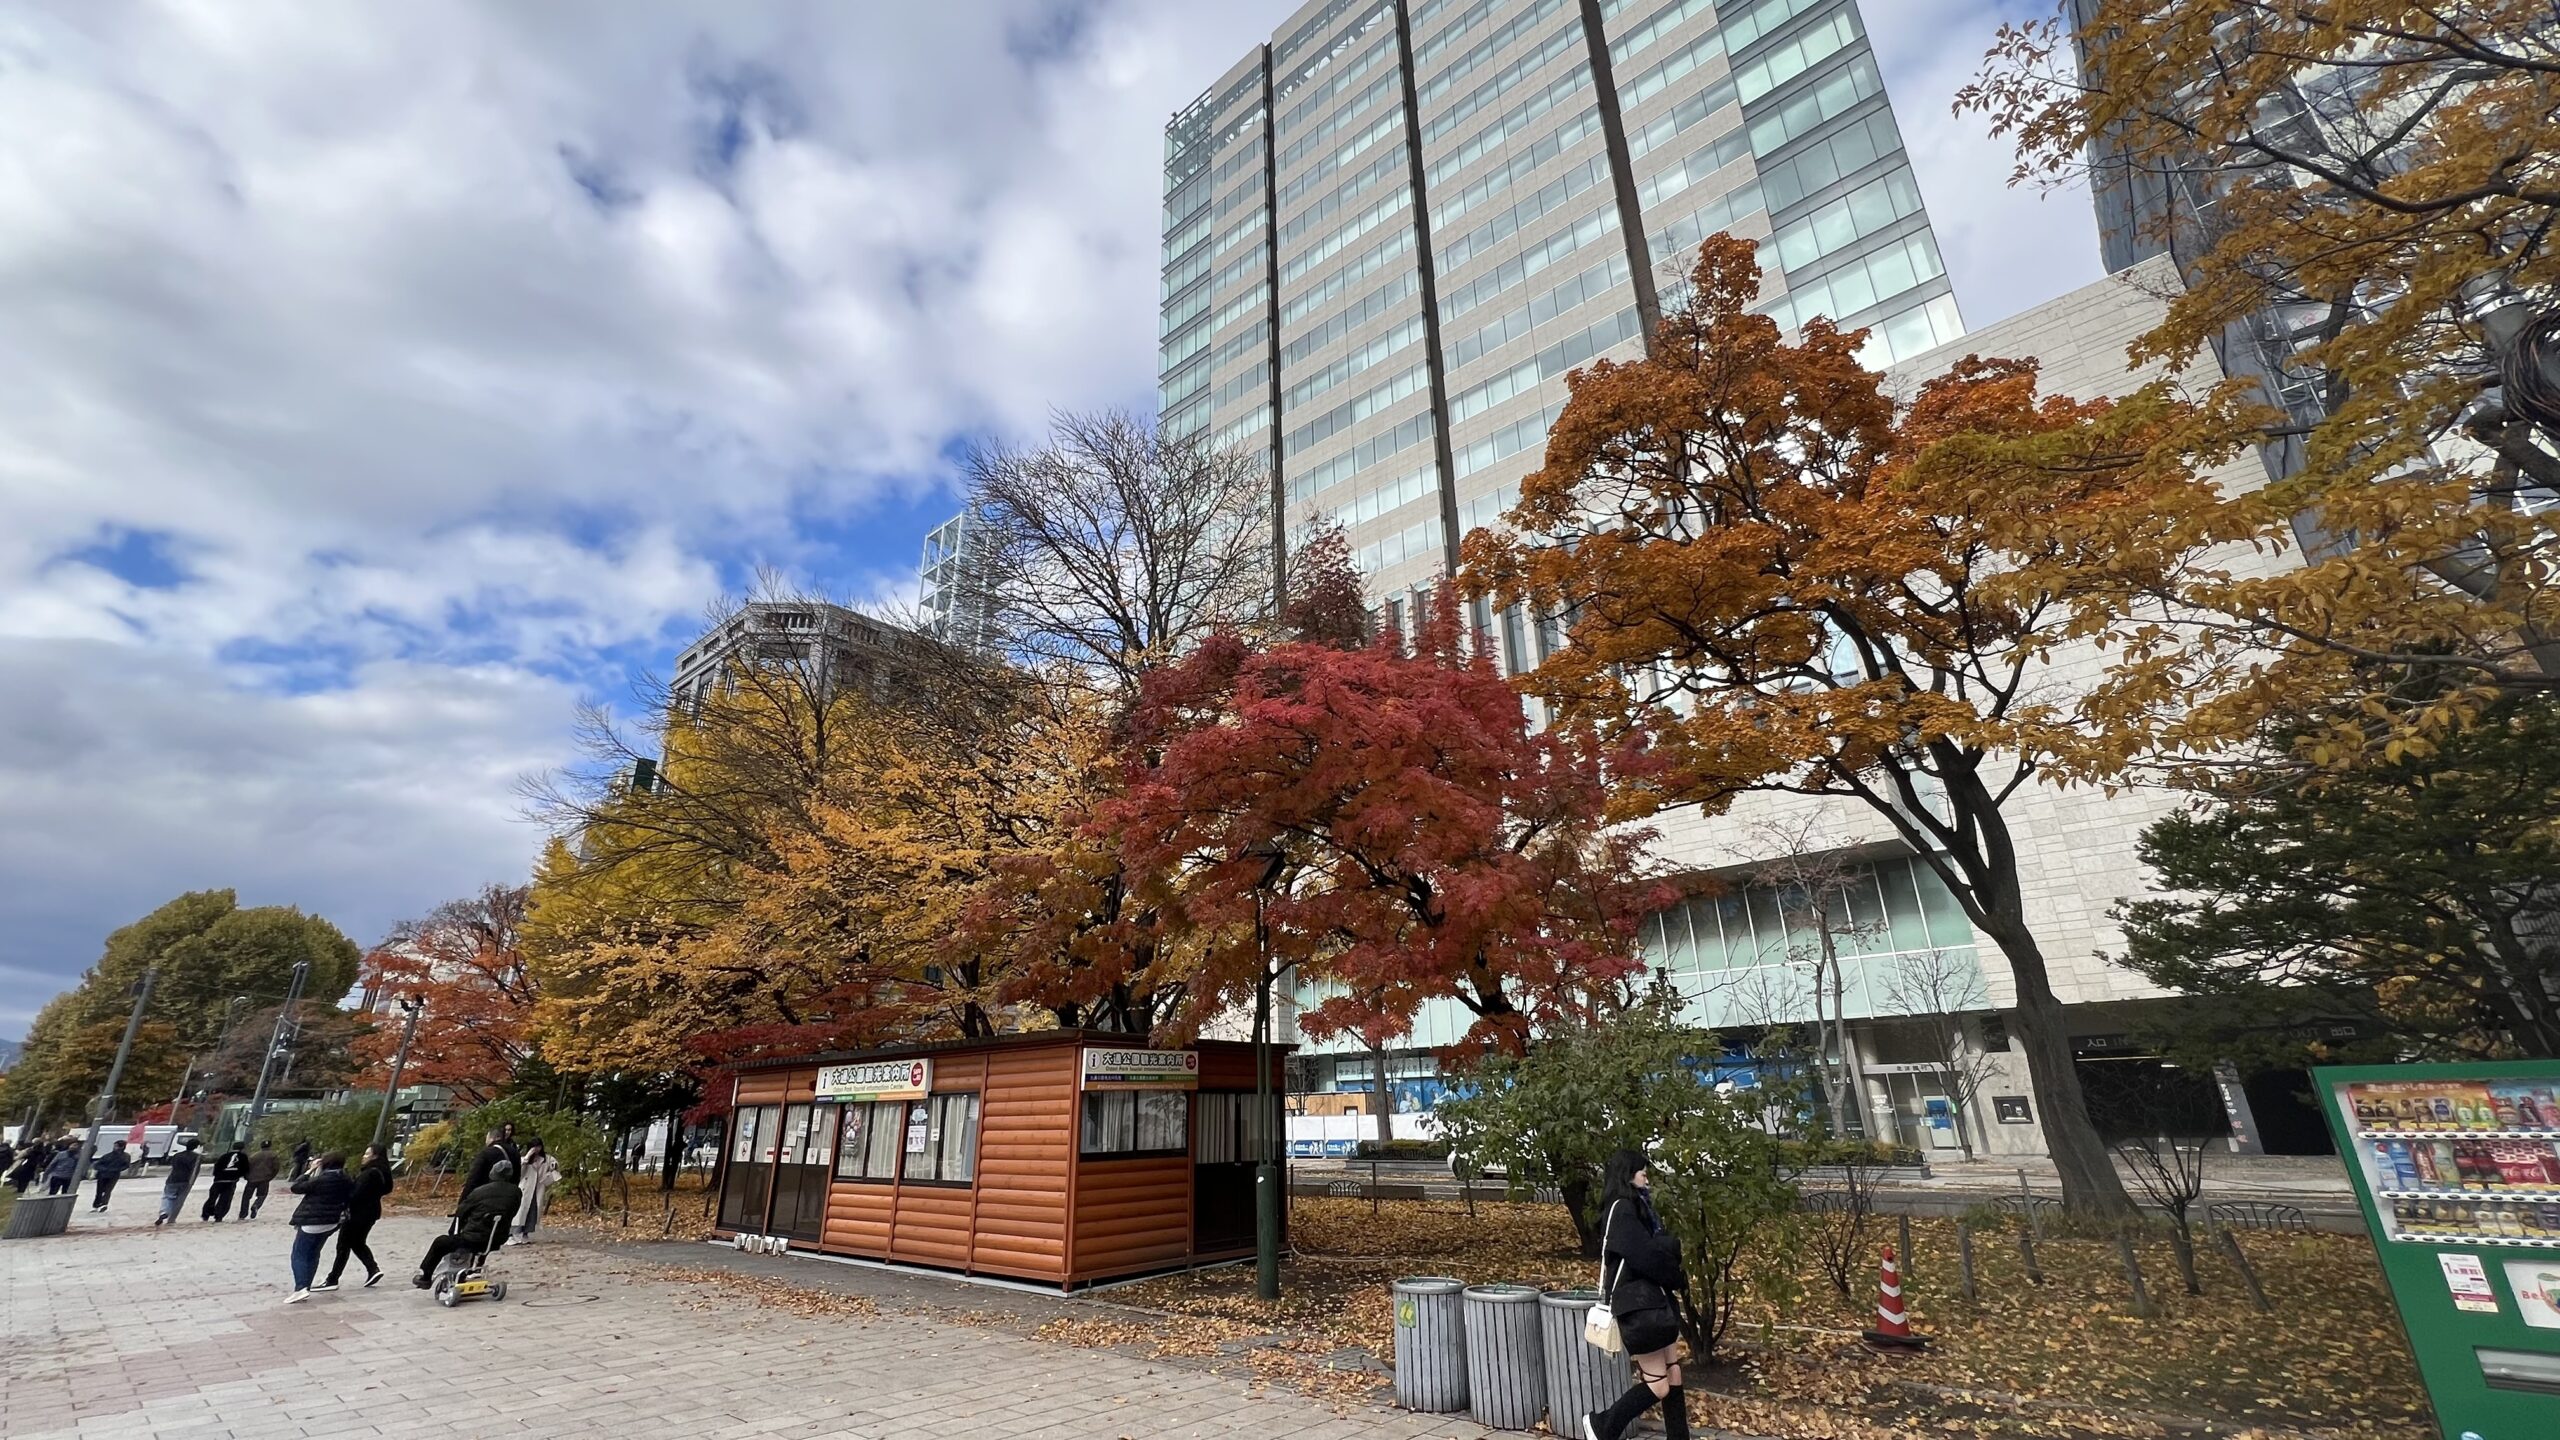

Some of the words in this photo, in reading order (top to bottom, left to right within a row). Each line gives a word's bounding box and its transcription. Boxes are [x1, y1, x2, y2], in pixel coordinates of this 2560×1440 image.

[2330, 1025, 2357, 1037] 出口
[2087, 1038, 2107, 1048] 入口
[1102, 1051, 1184, 1067] 大通公園観光案内所
[831, 1063, 911, 1086] 大通公園観光案内所
